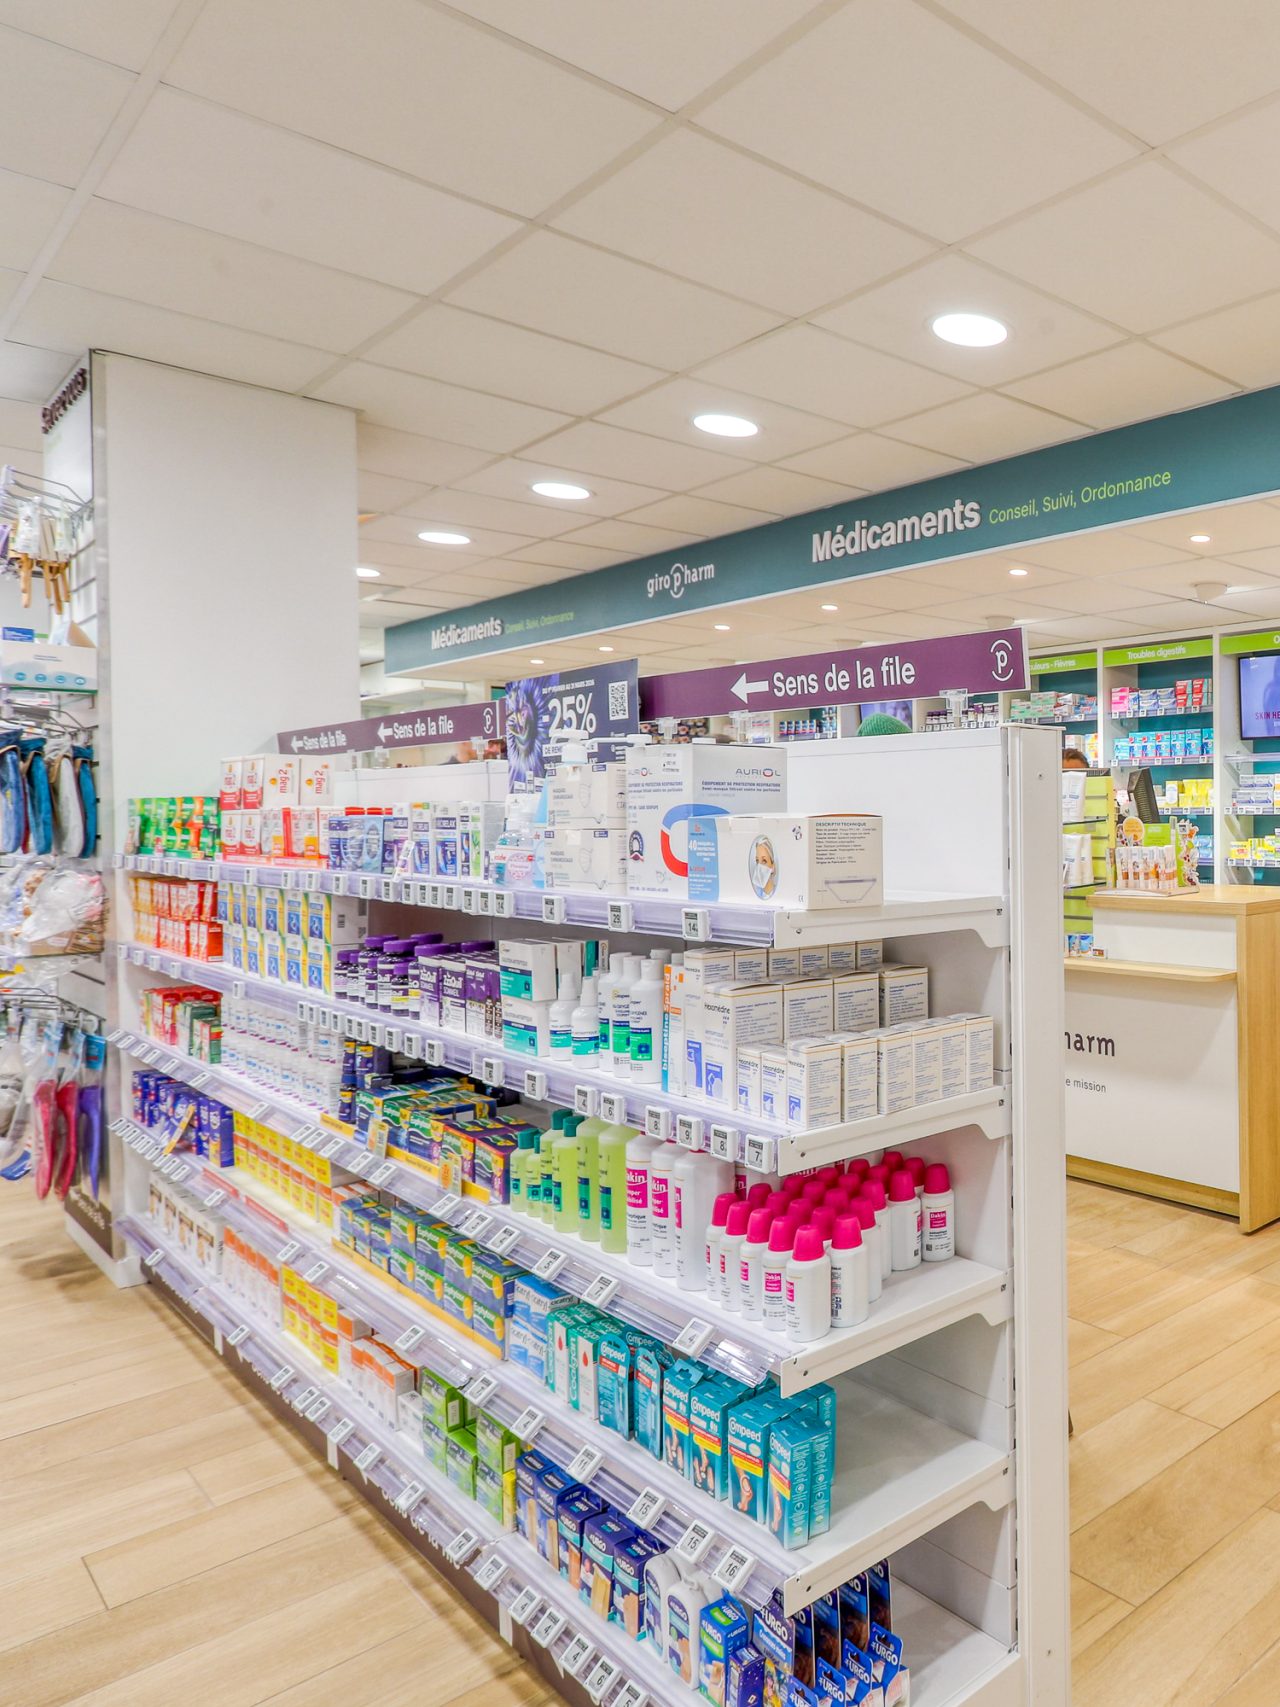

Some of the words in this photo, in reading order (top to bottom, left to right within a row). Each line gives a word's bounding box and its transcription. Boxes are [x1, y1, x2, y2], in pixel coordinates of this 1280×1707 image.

[811, 498, 981, 563] Médicaments
[989, 502, 1039, 525] Conseil,
[1042, 489, 1077, 513] Suivi,
[1081, 470, 1172, 503] Ordonnance
[646, 561, 715, 598] giropharm
[431, 617, 502, 650] Médicaments
[1127, 649, 1155, 661] Troubles
[773, 662, 819, 697] Sens
[824, 663, 851, 692] de
[856, 659, 876, 689] la
[881, 656, 916, 687] file
[542, 692, 597, 734] -25%
[393, 720, 413, 740] Sens
[414, 720, 428, 738] de
[428, 718, 438, 737] la
[438, 717, 454, 735] file
[1073, 1078, 1107, 1093] mission
[600, 1341, 626, 1363] Compeed
[664, 1378, 689, 1404] Compeed
[691, 1397, 721, 1423] Compeed
[728, 1416, 762, 1443] Compeed
[769, 1432, 791, 1462] Compeed
[561, 1515, 577, 1532] URGO
[589, 1533, 607, 1553] URGO
[616, 1557, 635, 1576] URGO
[670, 1599, 688, 1622] URGO
[722, 1604, 739, 1621] URGO
[704, 1619, 722, 1644] URGO
[765, 1610, 789, 1642] URGO
[875, 1643, 899, 1665] URGO
[849, 1660, 870, 1684] URGO
[822, 1678, 845, 1703] URGO
